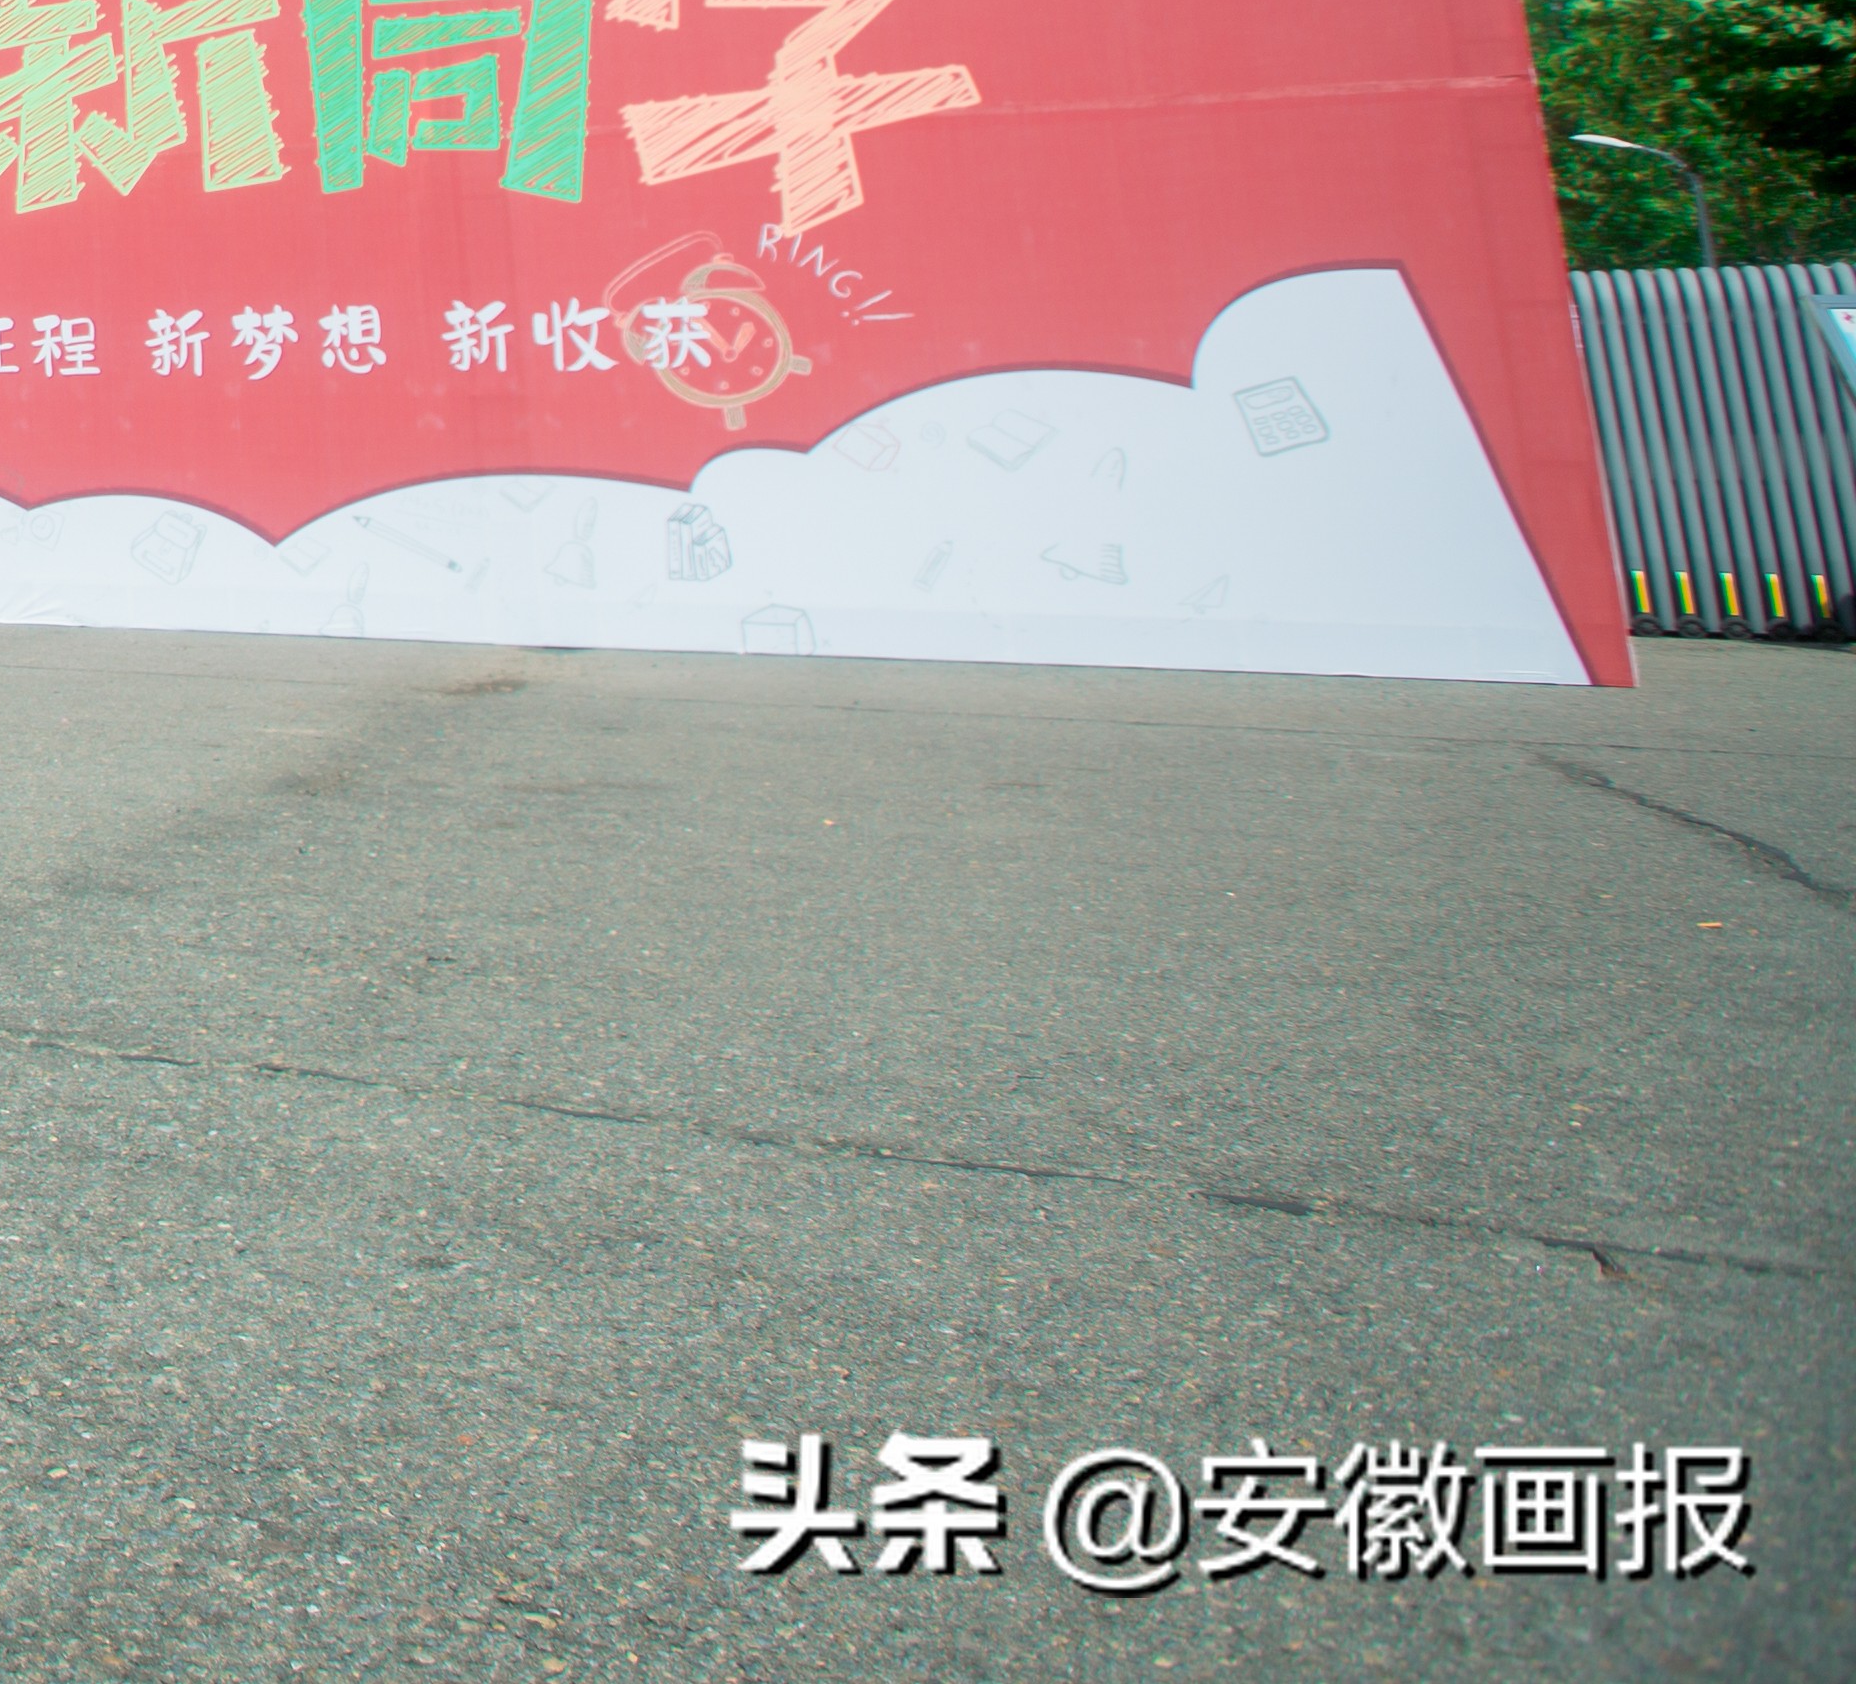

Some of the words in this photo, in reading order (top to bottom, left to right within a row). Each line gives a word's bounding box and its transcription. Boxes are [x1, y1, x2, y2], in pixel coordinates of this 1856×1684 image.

[145, 304, 387, 381] 新梦想
[442, 297, 712, 373] 新收获
